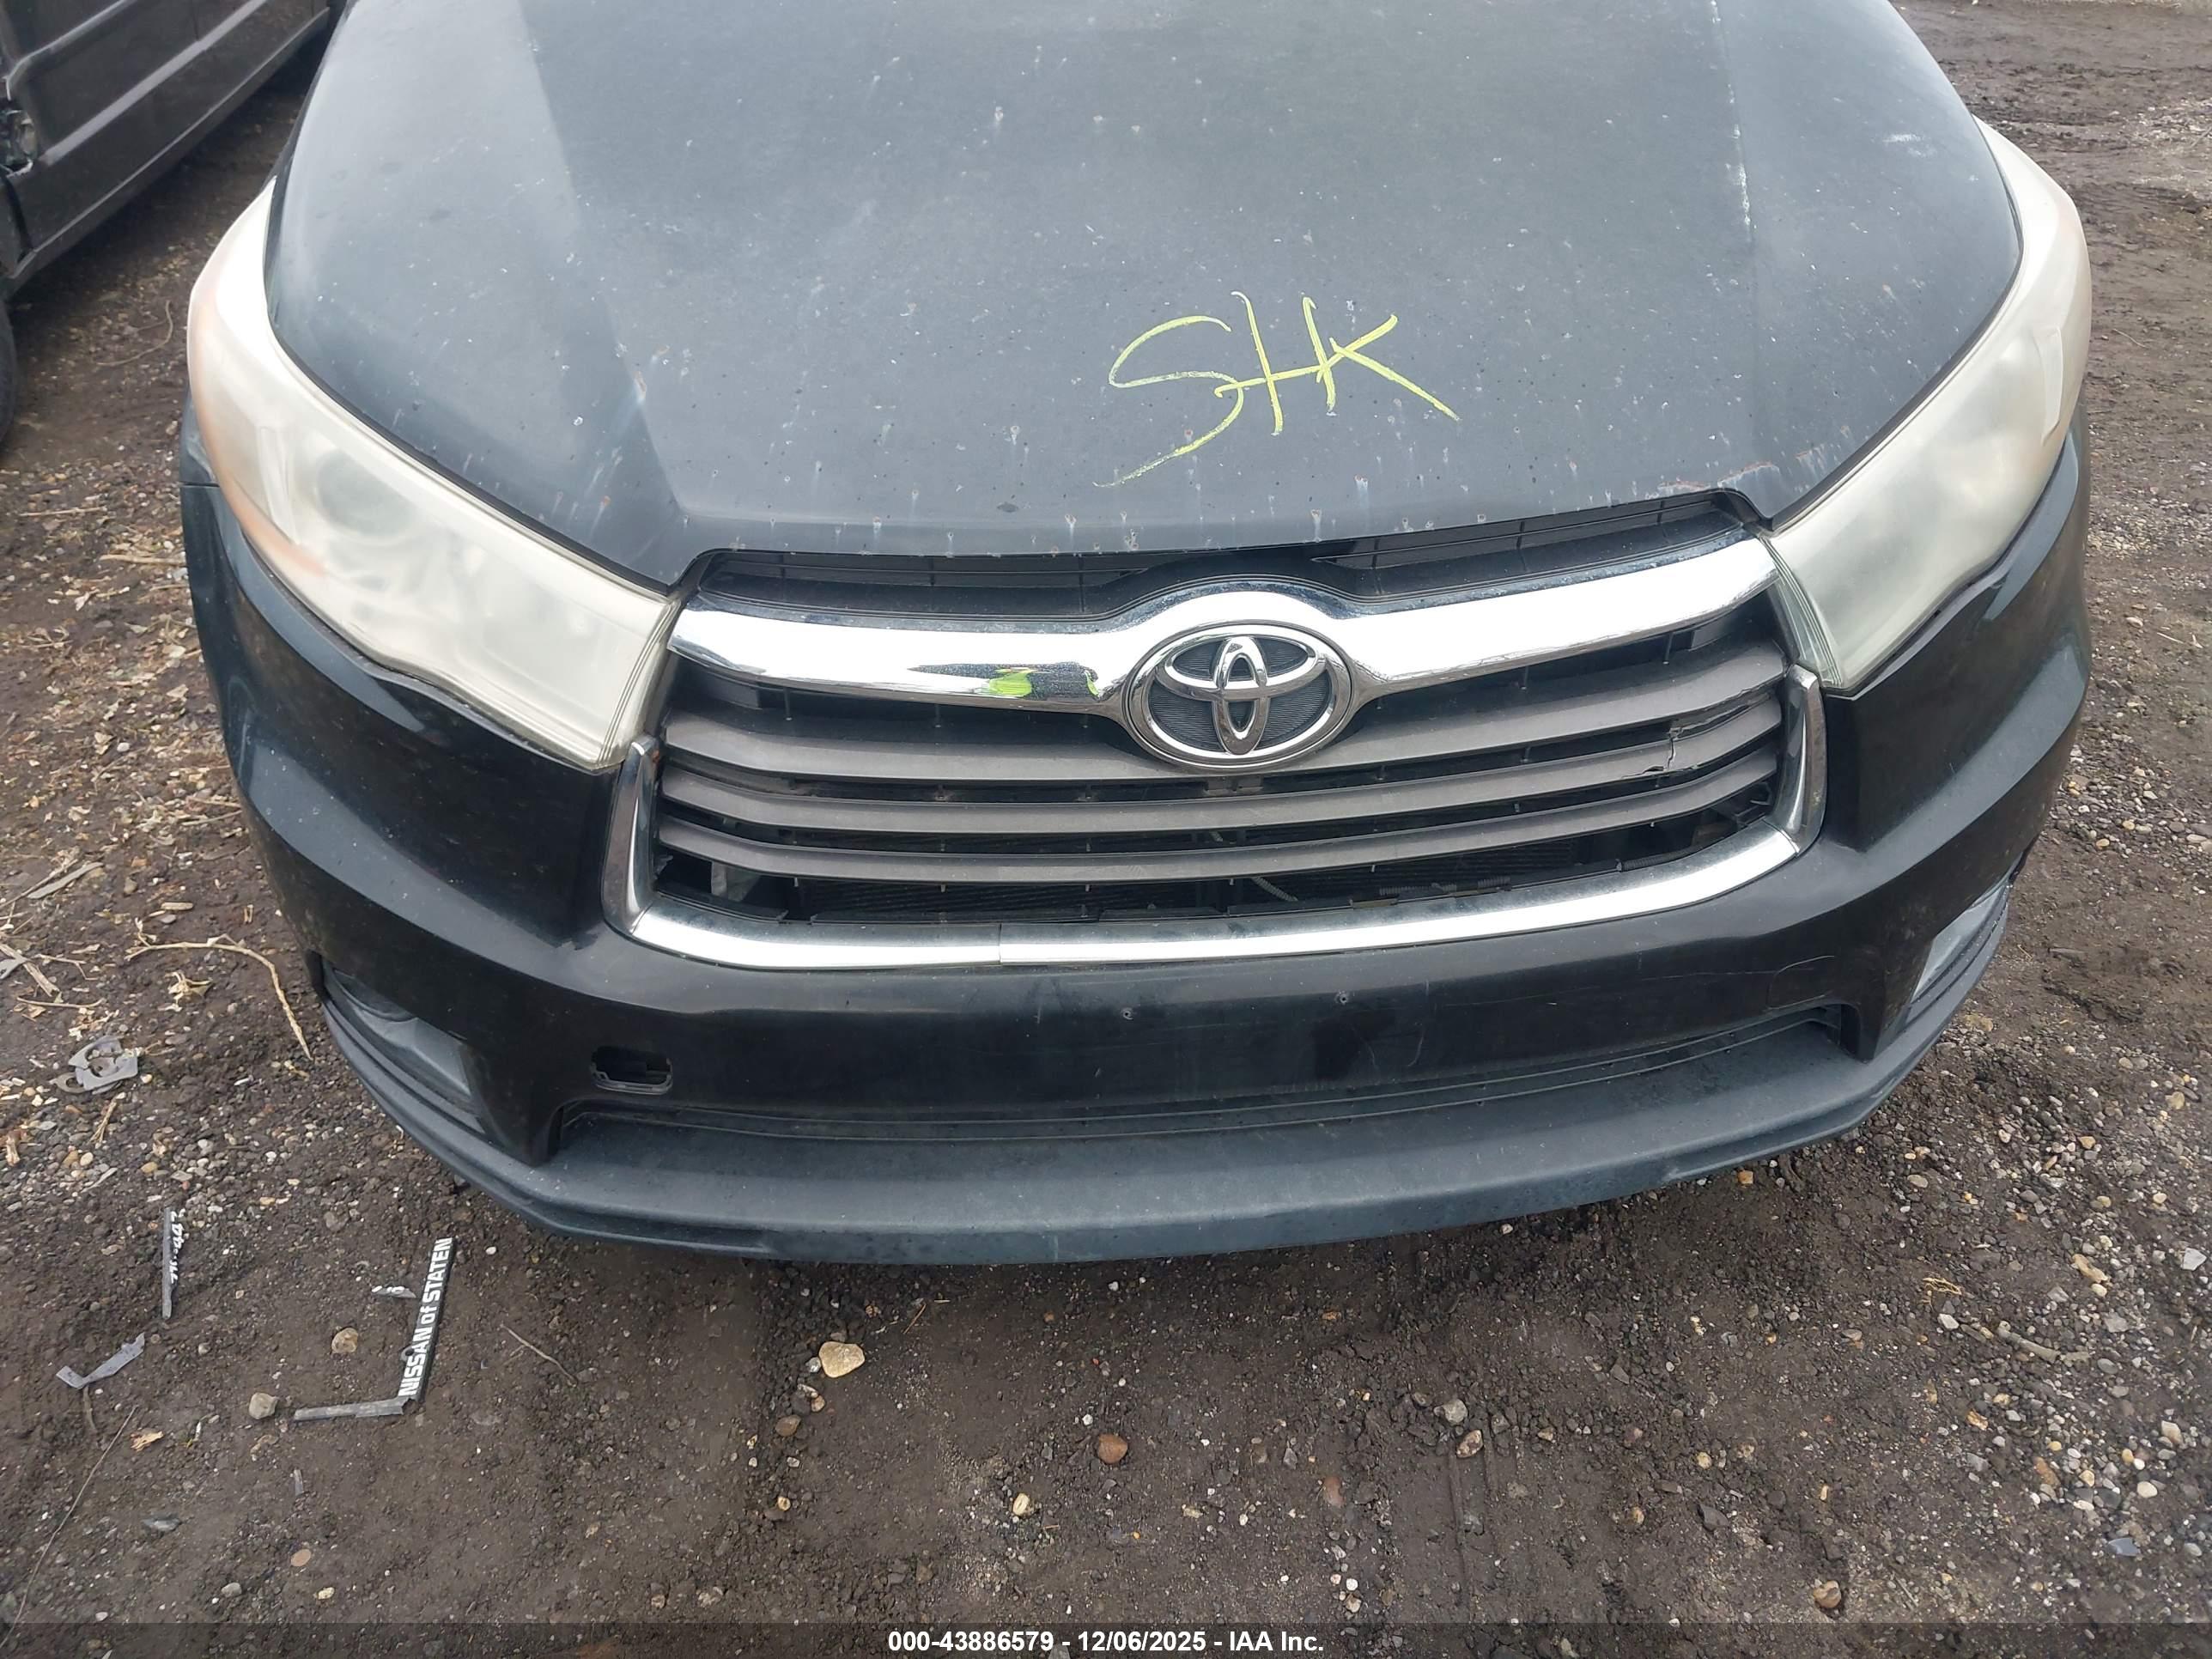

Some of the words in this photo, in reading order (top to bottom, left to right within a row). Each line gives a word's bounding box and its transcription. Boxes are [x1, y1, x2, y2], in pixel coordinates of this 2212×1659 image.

[422, 1237, 453, 1303] STATEN
[420, 1306, 437, 1325] of
[398, 1327, 433, 1396] NISSAN
